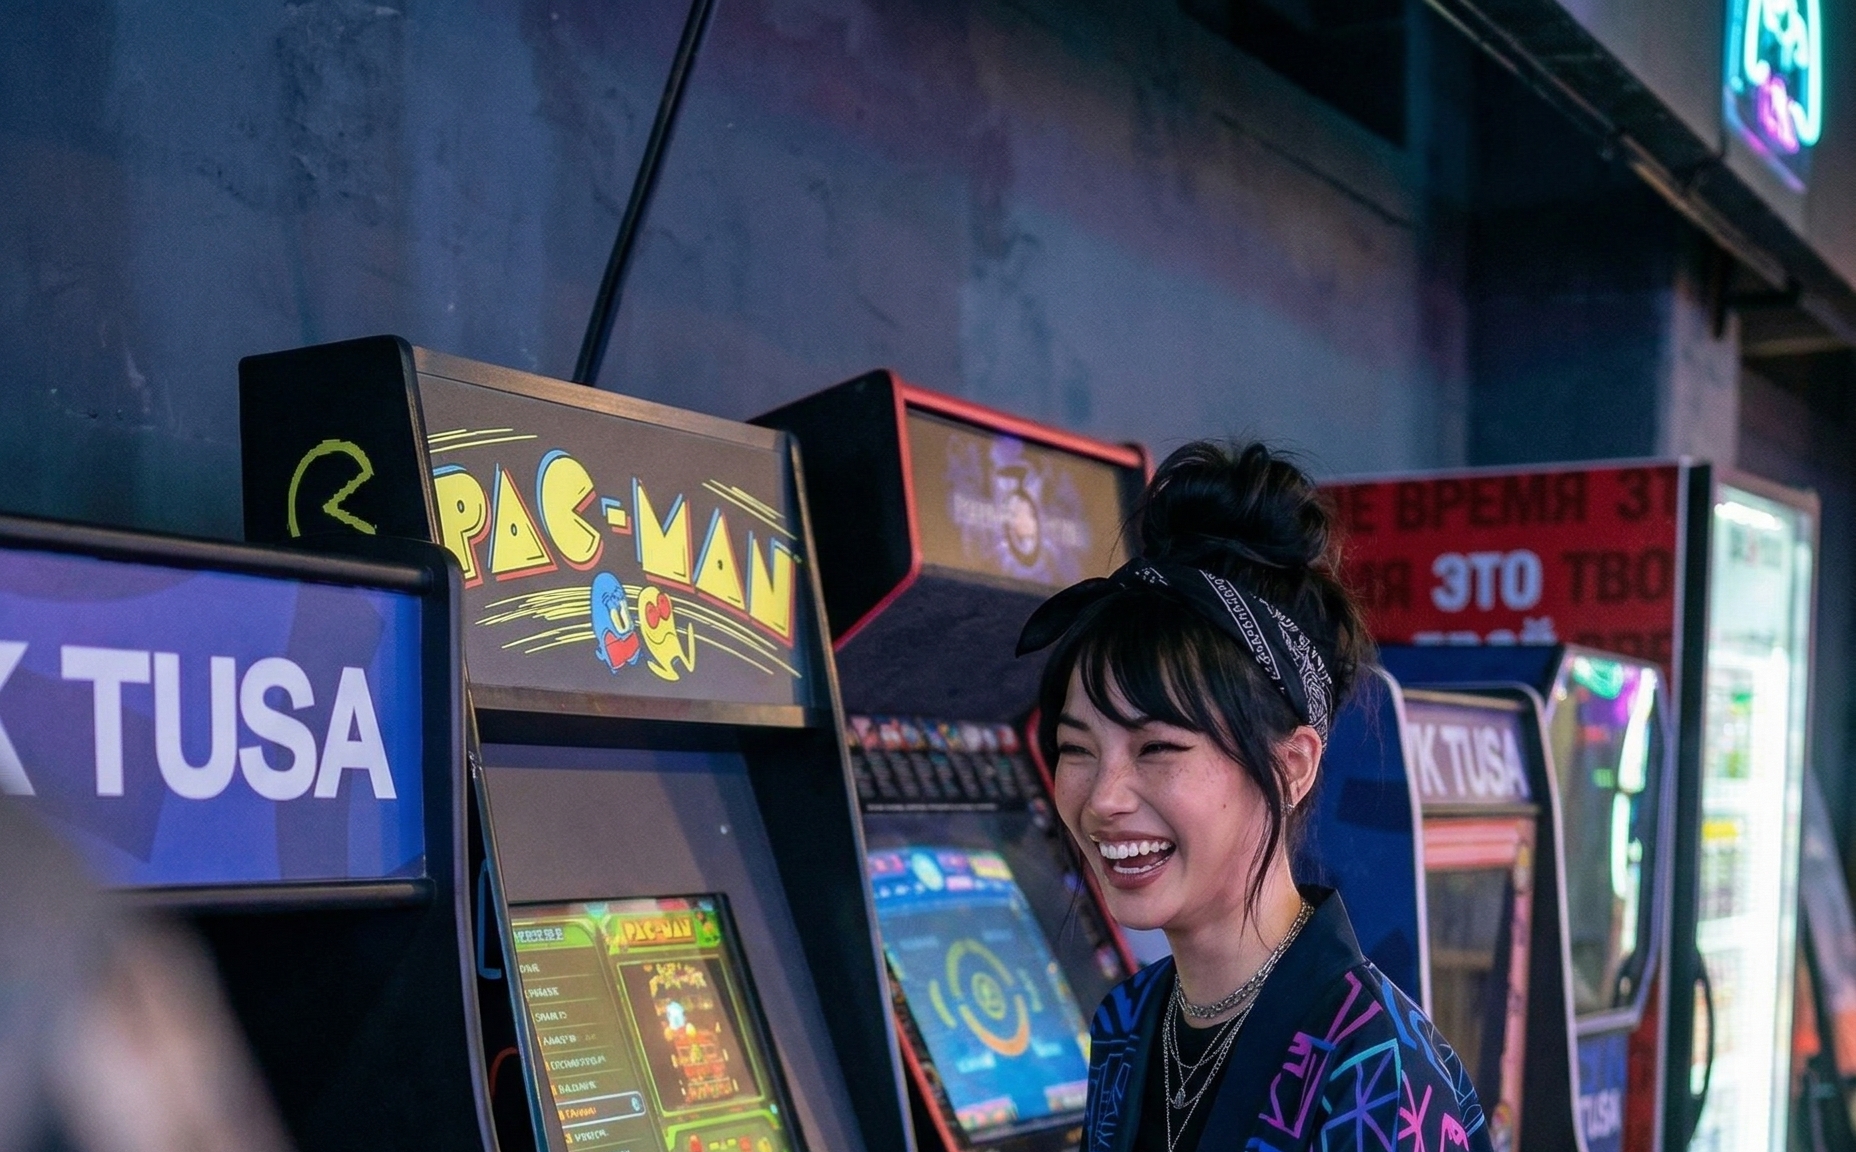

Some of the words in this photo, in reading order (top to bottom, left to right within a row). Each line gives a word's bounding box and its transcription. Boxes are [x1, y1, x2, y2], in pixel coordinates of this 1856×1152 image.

[1396, 470, 1588, 532] ВРЕМЯ
[433, 449, 796, 650] PAC-MAN
[1431, 548, 1543, 612] ЭТО
[61, 644, 397, 801] TUSA
[1439, 724, 1530, 797] TUSA
